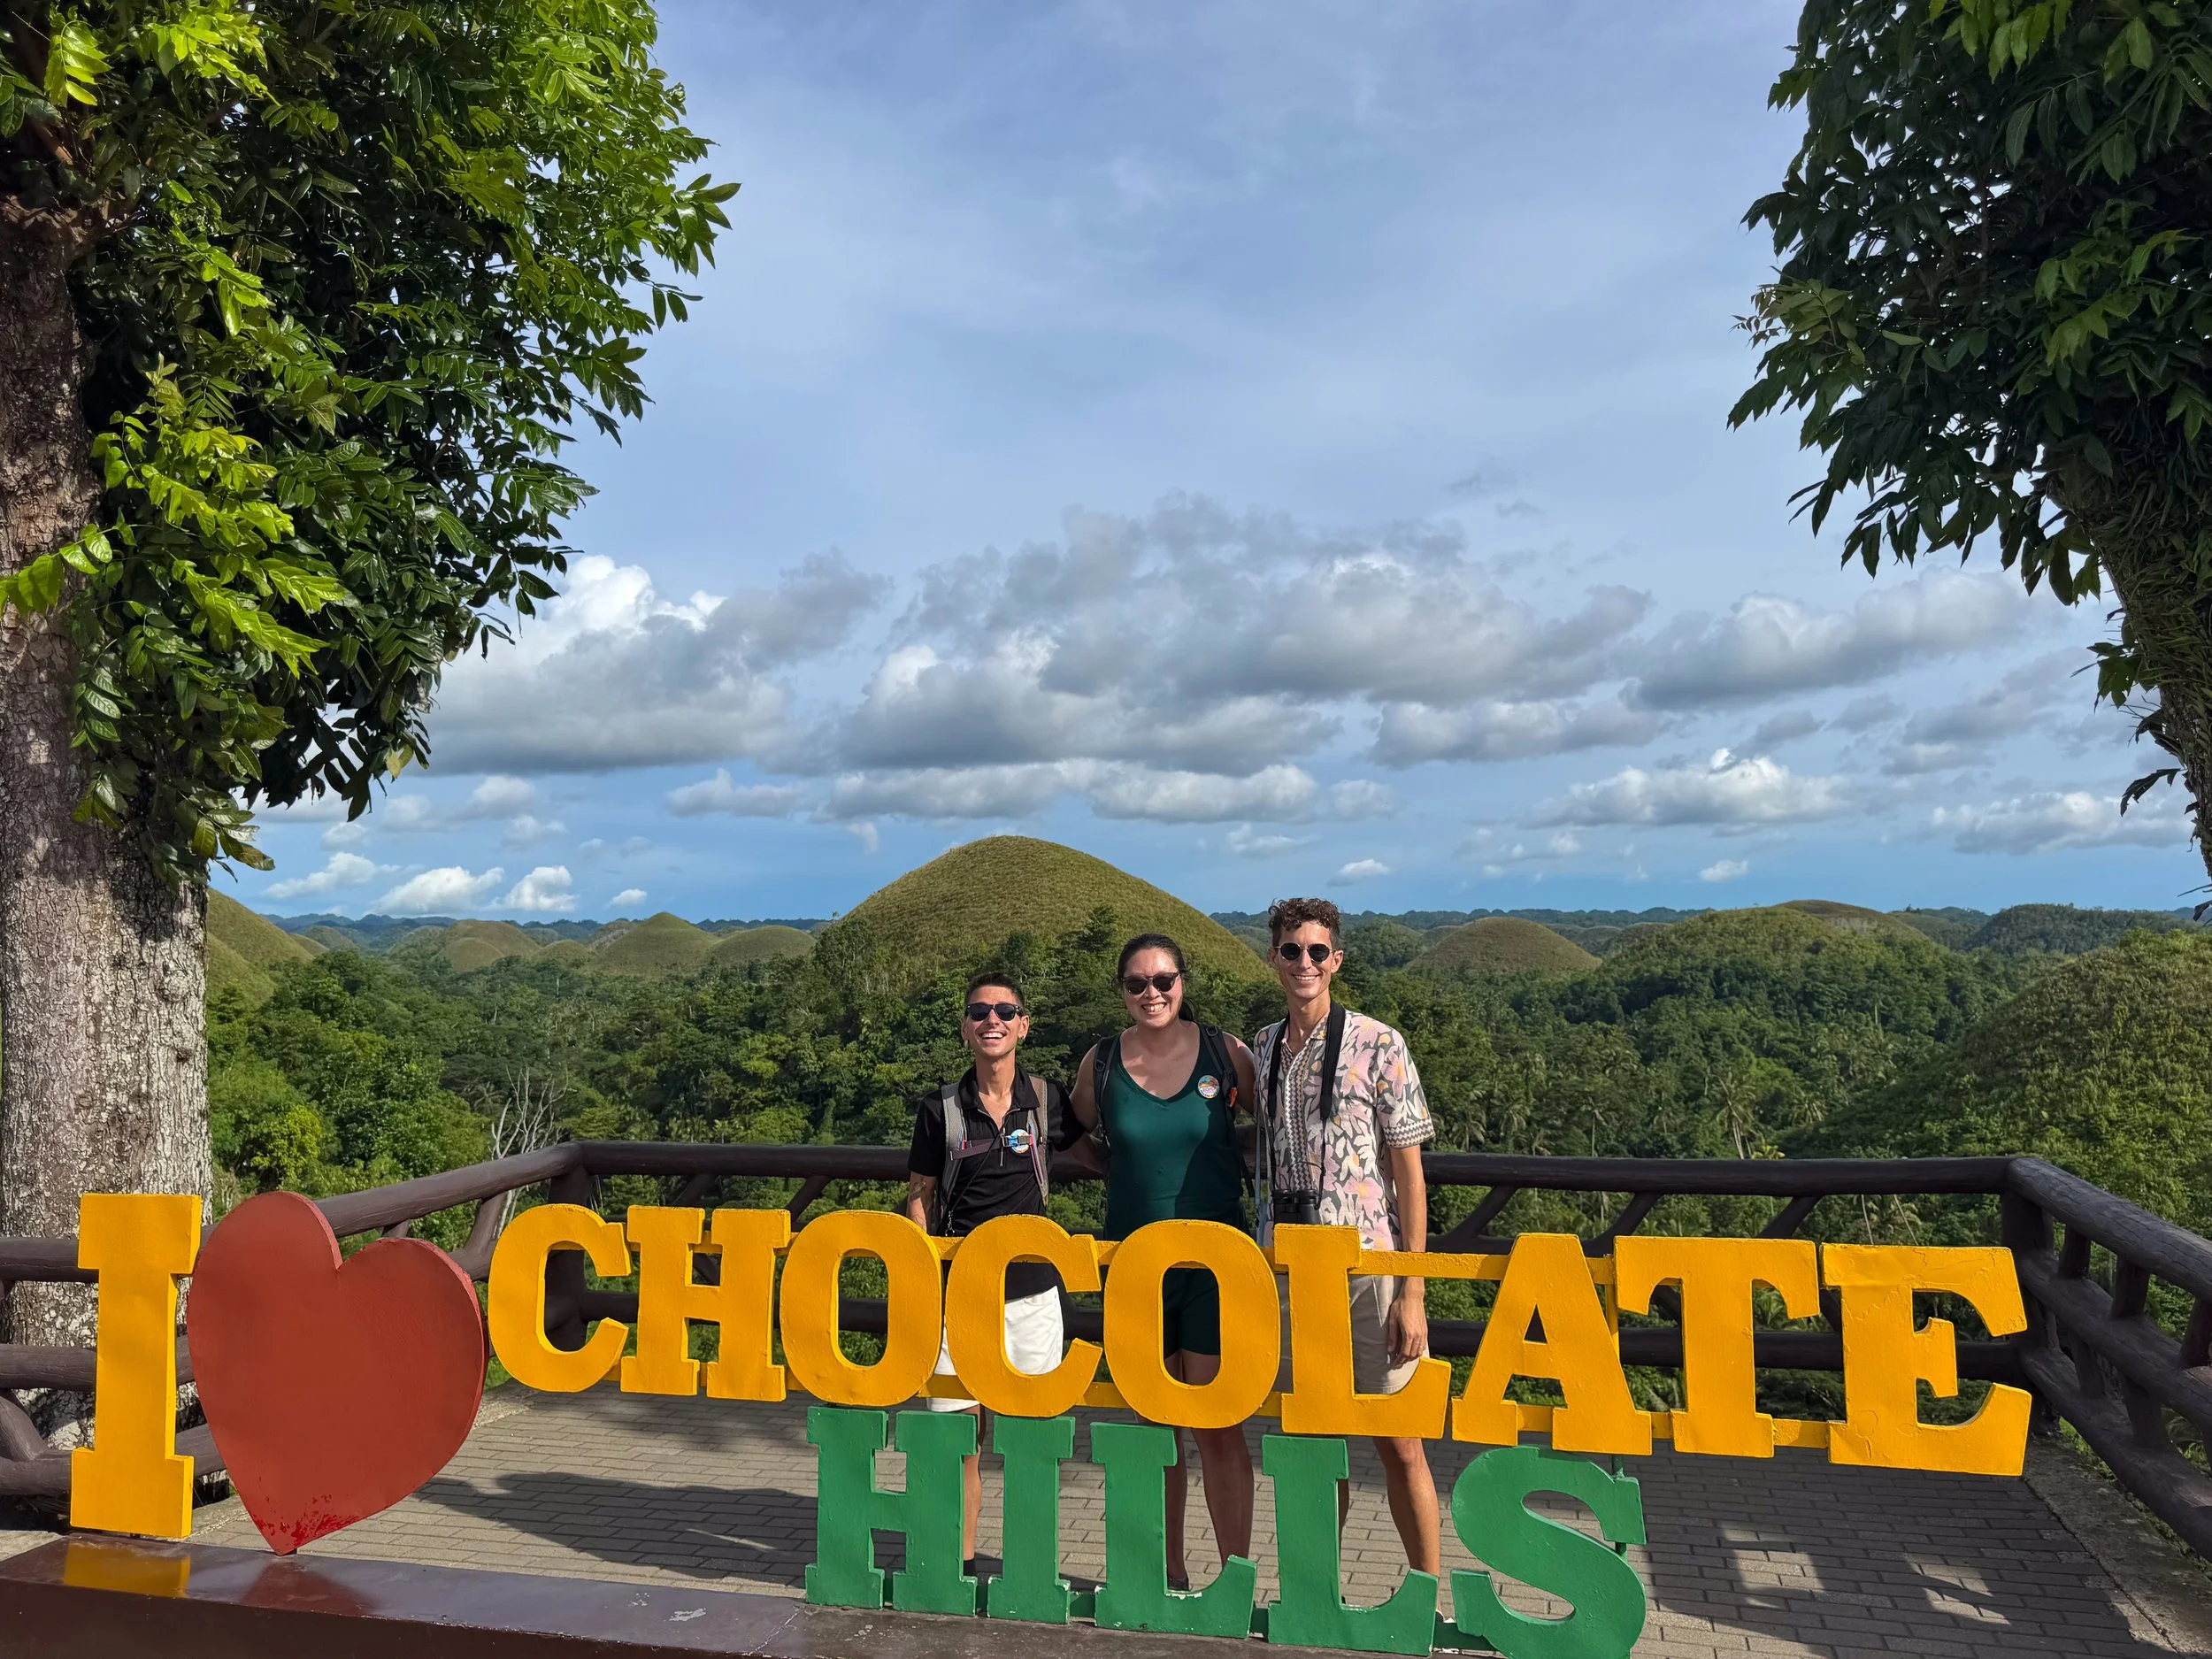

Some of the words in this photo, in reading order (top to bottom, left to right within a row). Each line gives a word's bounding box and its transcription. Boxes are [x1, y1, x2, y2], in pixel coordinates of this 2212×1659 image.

[70, 1193, 202, 1540] I
[487, 1202, 2032, 1477] CHOCOLATE
[805, 1405, 1647, 1659] HILLS
